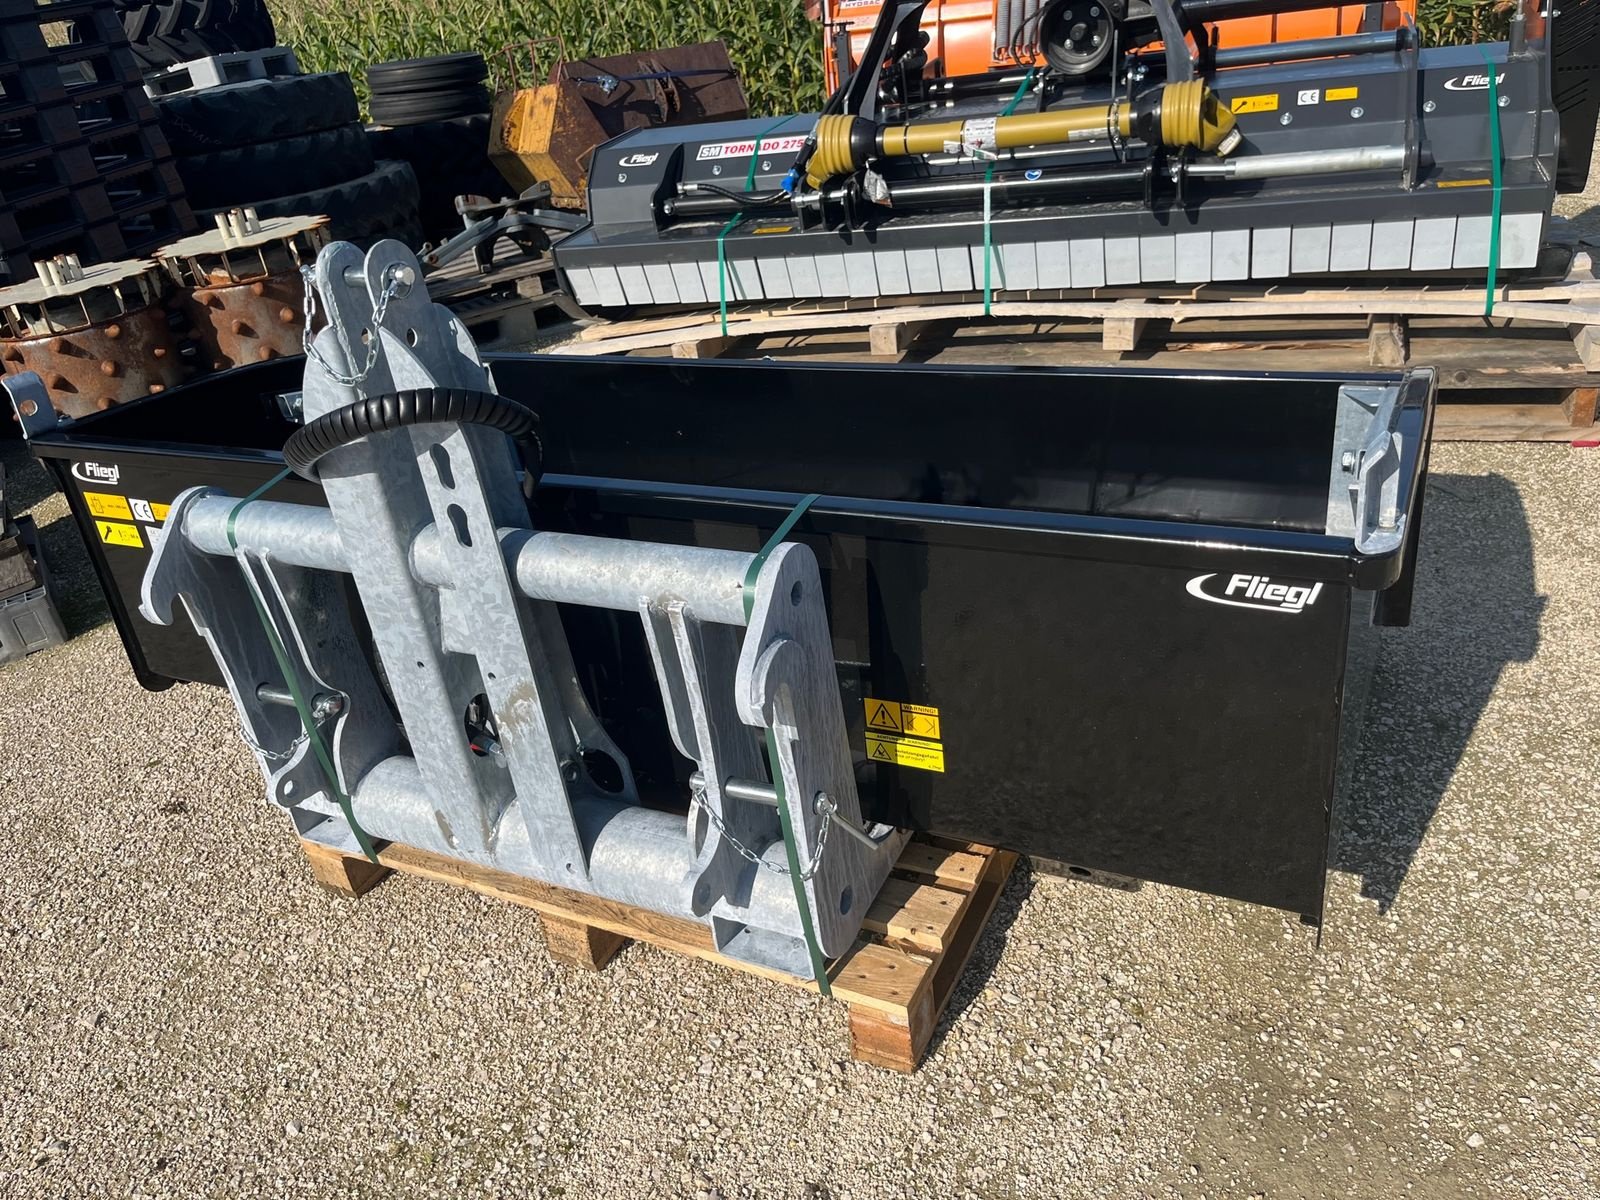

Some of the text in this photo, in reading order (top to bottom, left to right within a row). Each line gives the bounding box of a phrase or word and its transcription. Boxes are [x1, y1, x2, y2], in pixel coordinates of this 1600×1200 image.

[701, 146, 722, 157] SM
[782, 139, 804, 150] 275
[85, 462, 119, 481] Fliegl
[1225, 573, 1324, 609] Fliegl
[903, 704, 936, 713] WARNING!
